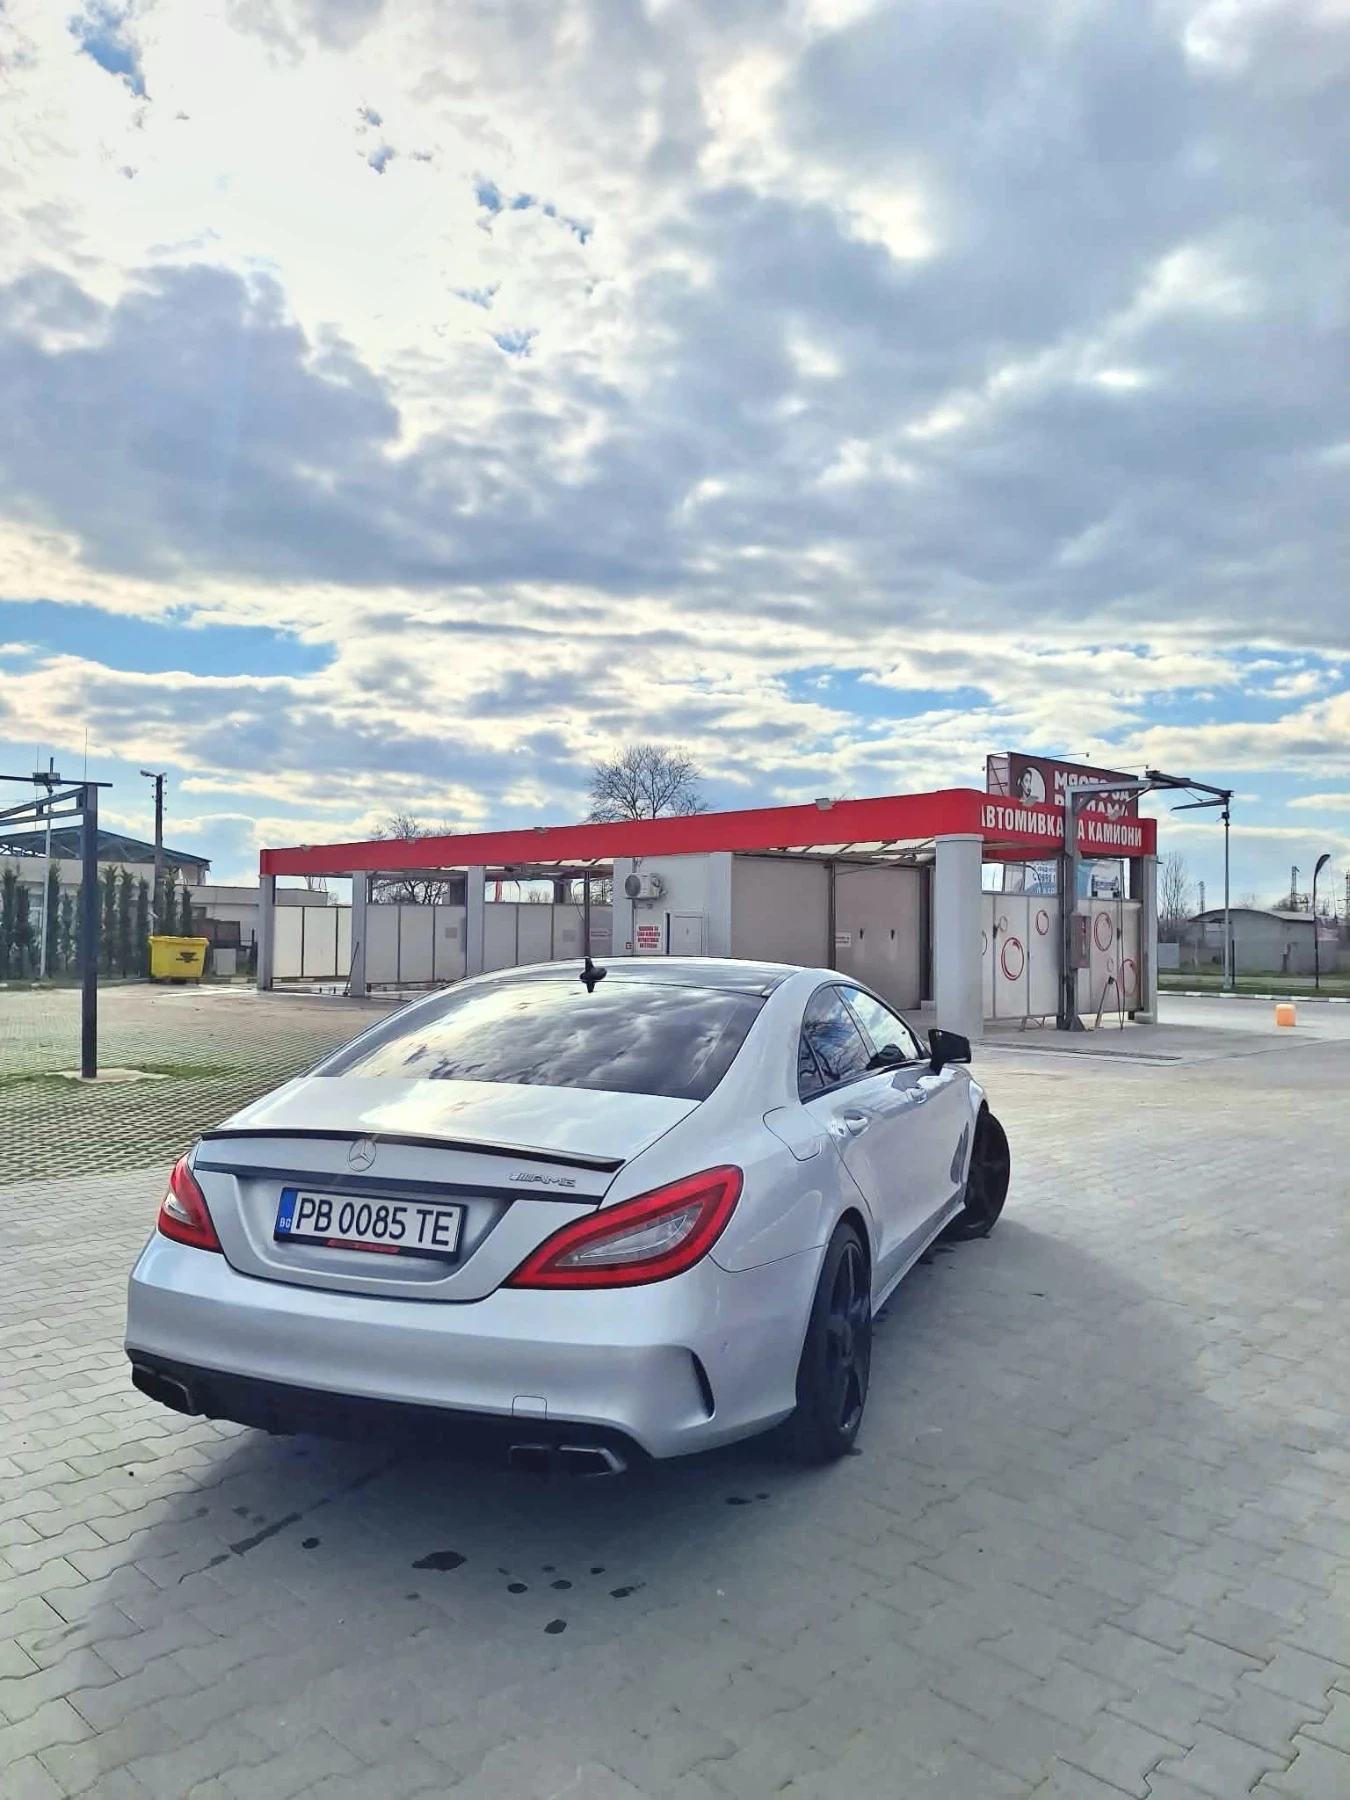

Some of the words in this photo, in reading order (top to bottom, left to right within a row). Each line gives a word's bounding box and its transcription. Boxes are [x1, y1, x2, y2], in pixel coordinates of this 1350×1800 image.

[1077, 819, 1085, 841] А
[1088, 820, 1142, 847] КАМИОНИ
[279, 1217, 292, 1228] BG
[296, 1197, 333, 1232] PB
[338, 1202, 408, 1240] 0085
[416, 1209, 453, 1246] TE
